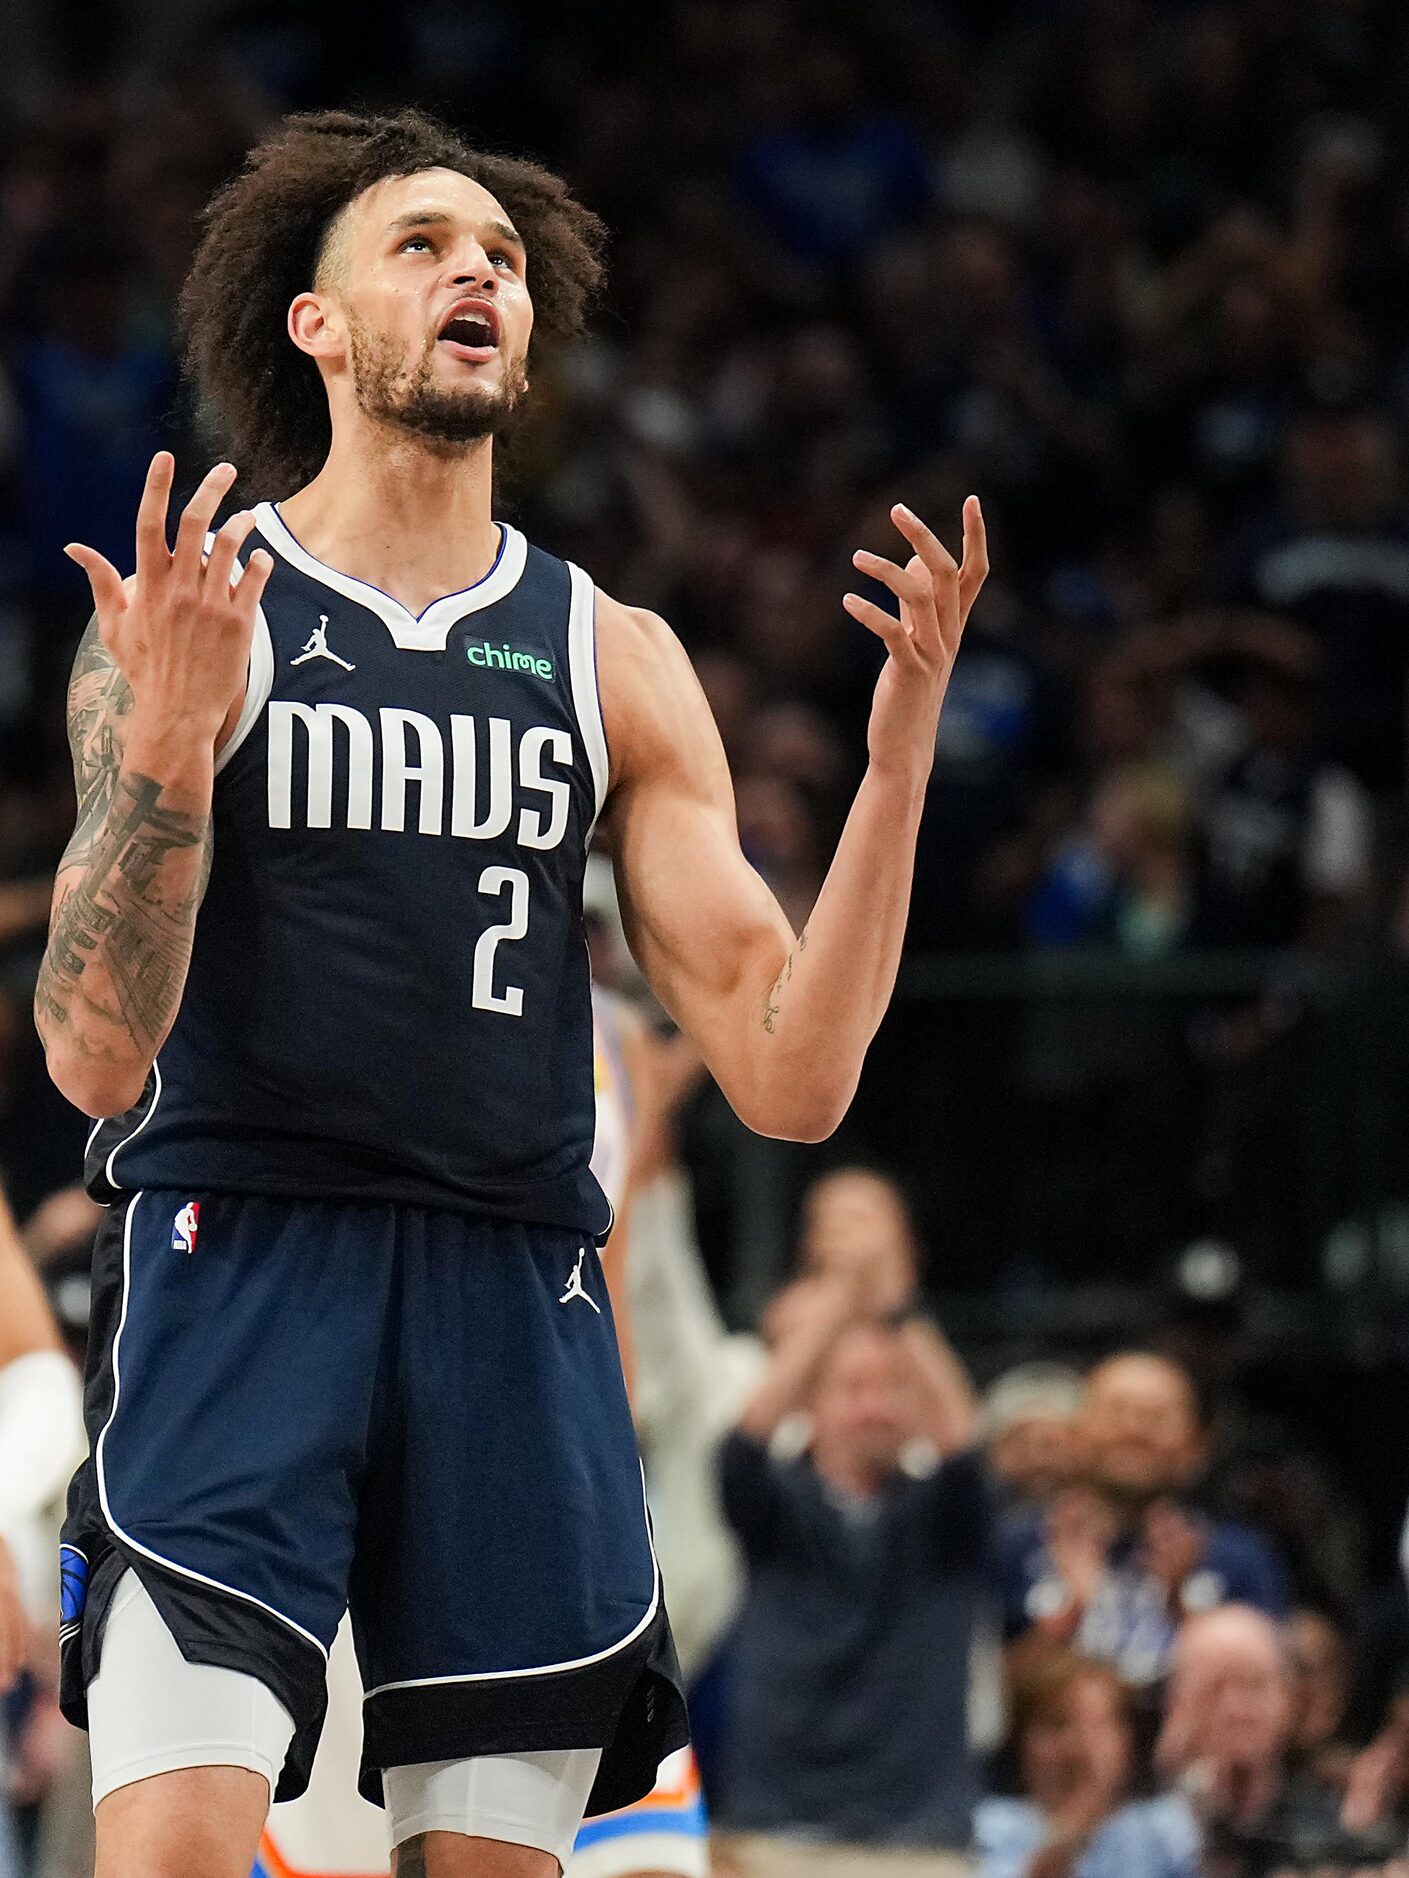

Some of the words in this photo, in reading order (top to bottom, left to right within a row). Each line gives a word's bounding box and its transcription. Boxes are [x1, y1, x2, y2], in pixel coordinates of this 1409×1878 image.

[467, 642, 553, 680] chime
[268, 701, 574, 850] MAVS
[472, 866, 530, 1016] 2
